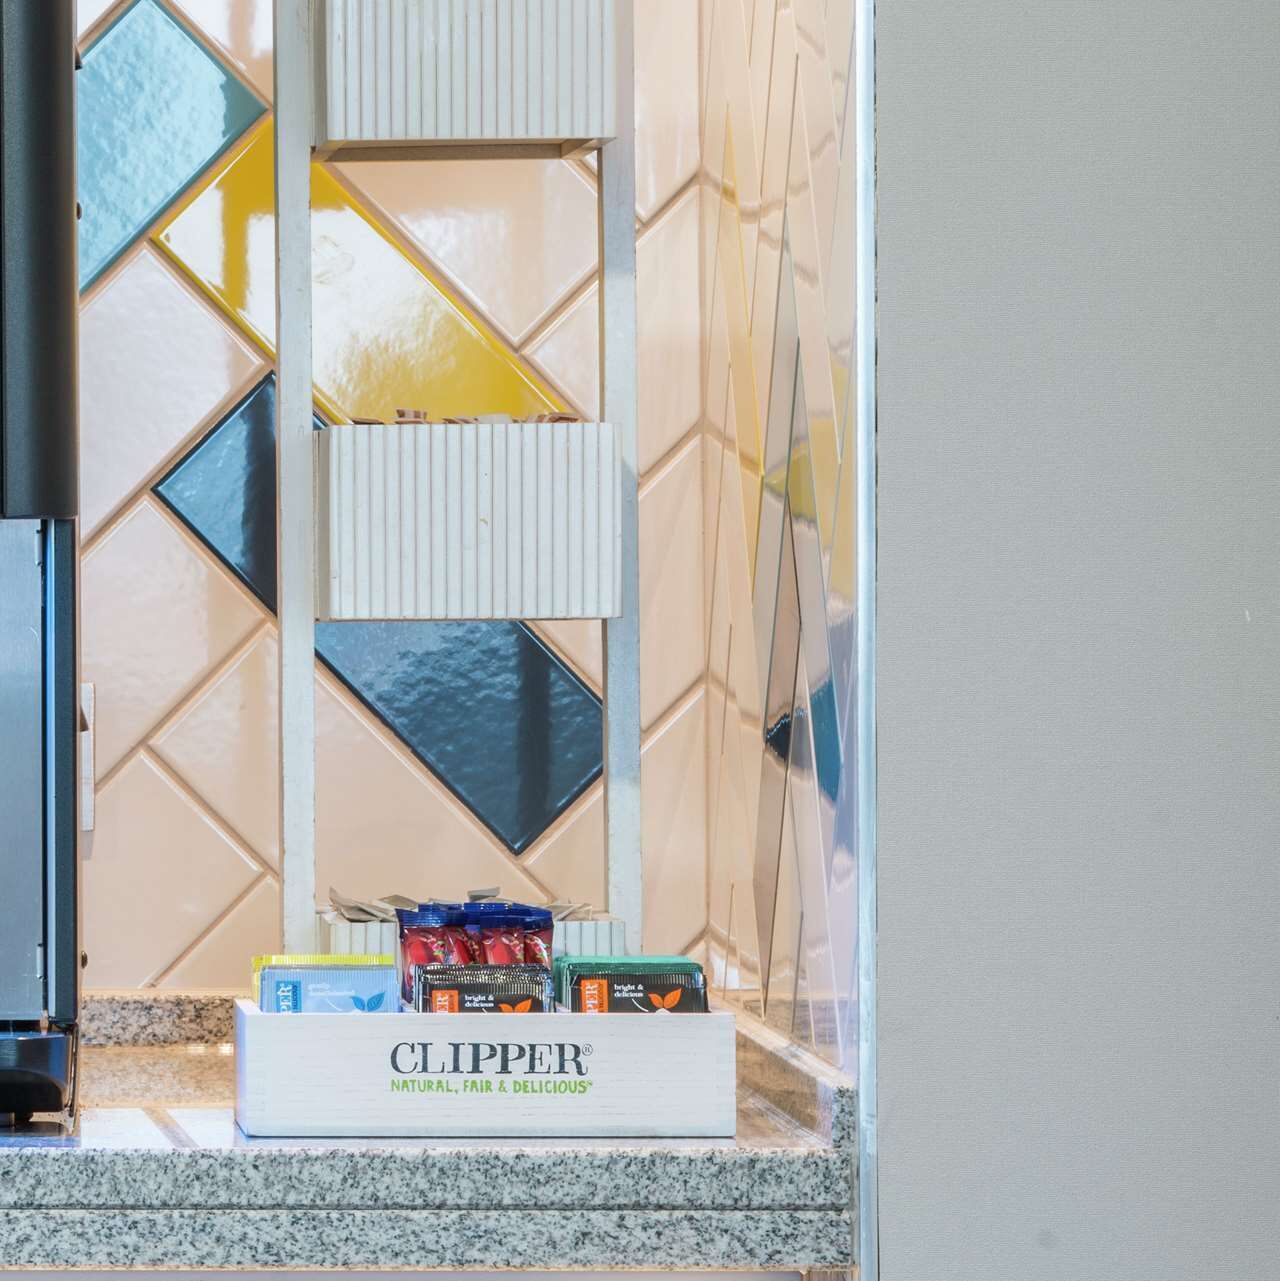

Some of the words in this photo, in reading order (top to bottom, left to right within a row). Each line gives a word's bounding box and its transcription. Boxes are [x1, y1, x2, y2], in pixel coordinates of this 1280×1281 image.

[464, 994, 486, 1002] bright
[391, 1079, 459, 1095] NATURAL,
[463, 1079, 494, 1094] FAIR
[498, 1079, 508, 1094] &
